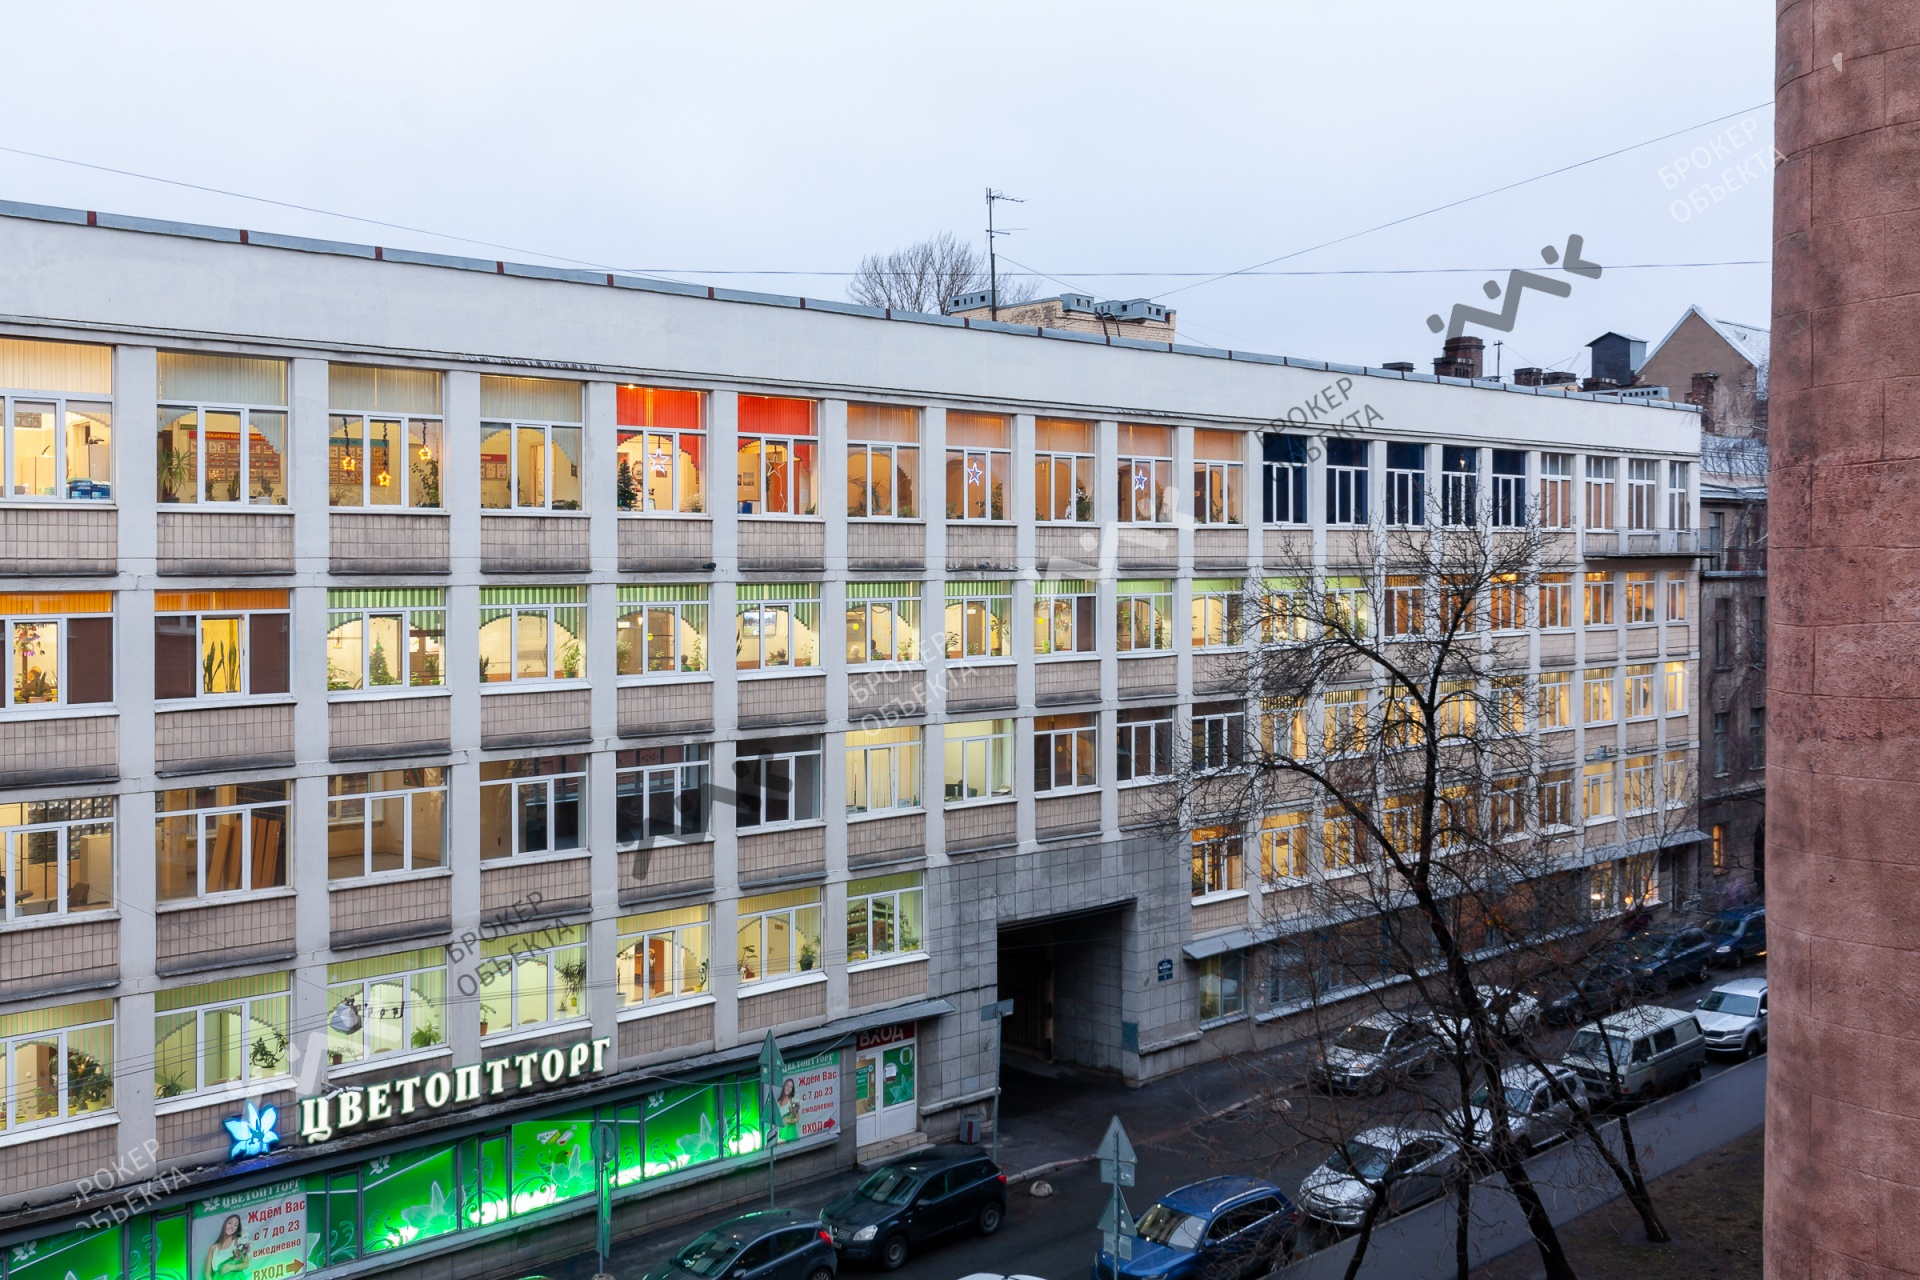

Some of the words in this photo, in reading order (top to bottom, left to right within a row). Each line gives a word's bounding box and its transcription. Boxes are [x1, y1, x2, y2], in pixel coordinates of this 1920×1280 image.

[859, 1025, 904, 1047] ВХОД
[798, 1074, 821, 1087] Ждём
[822, 1071, 837, 1081] Вас
[300, 1036, 612, 1144] ЦВЕТОПТТОРГ
[802, 1093, 807, 1101] с
[808, 1091, 812, 1099] 7
[814, 1089, 823, 1099] до
[824, 1087, 833, 1096] 23
[801, 1101, 834, 1114] ежедневно
[802, 1121, 823, 1134] ВХОД
[247, 1204, 282, 1224] Ждём
[285, 1200, 305, 1214] Вас
[254, 1231, 260, 1241] с
[262, 1227, 269, 1239] 7
[271, 1225, 285, 1238] до
[287, 1219, 300, 1232] 23
[252, 1238, 301, 1258] ежедневно
[253, 1264, 284, 1280] ВХОД
